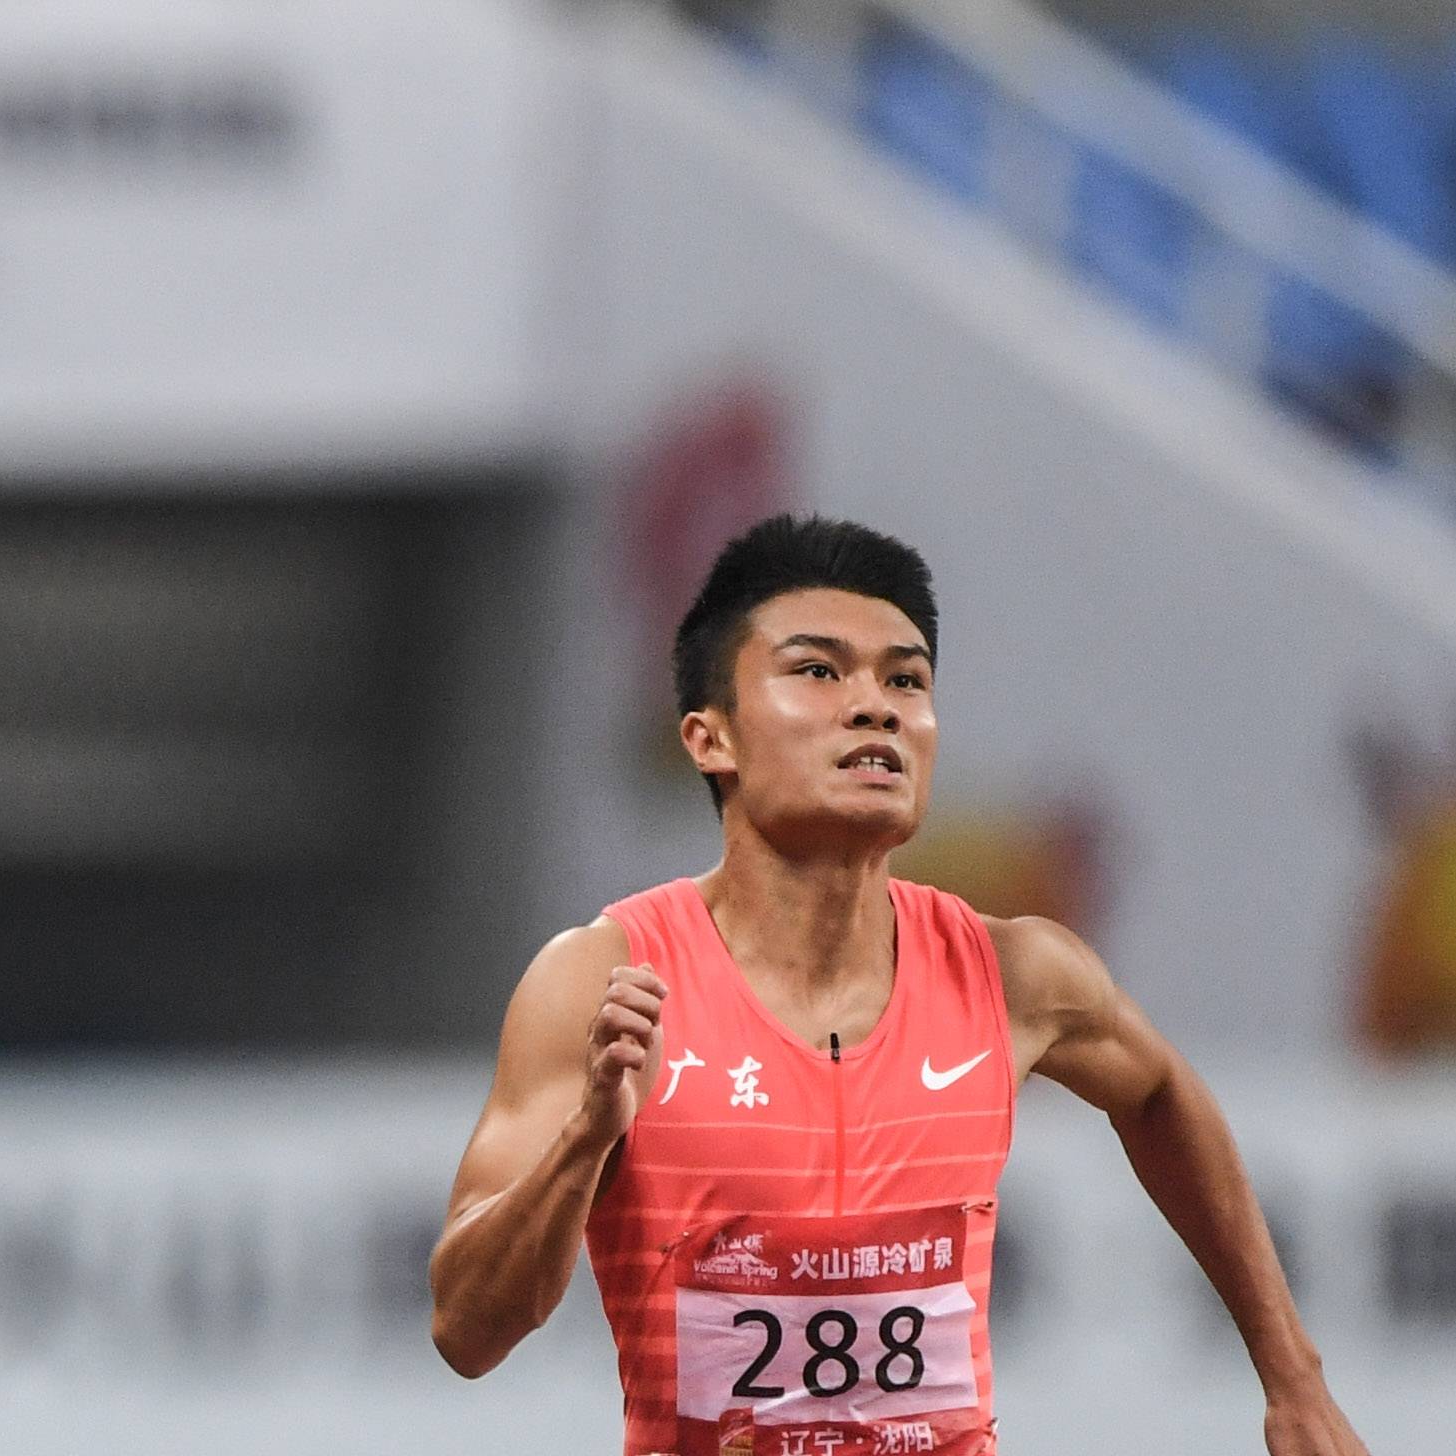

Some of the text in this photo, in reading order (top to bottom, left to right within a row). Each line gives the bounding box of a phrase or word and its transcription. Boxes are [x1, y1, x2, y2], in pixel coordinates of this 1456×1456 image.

[659, 1048, 771, 1109] 广东
[790, 1236, 954, 1282] 火山源冷矿泉
[731, 1305, 926, 1399] 288
